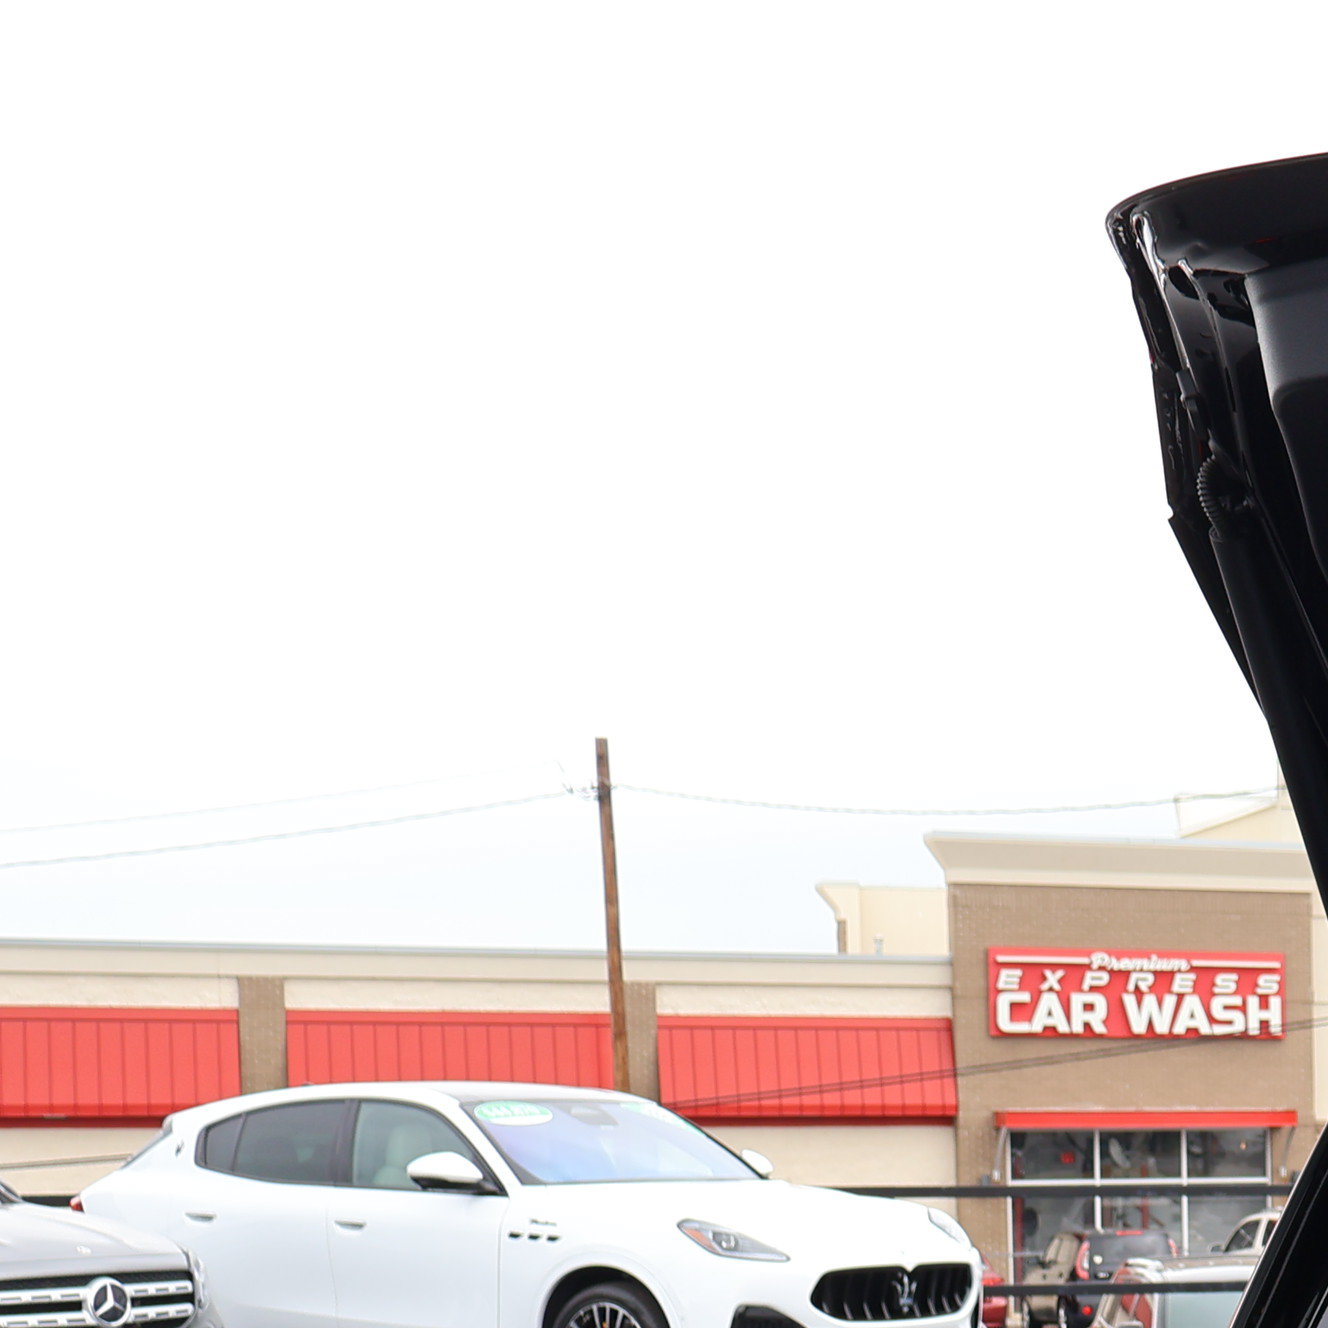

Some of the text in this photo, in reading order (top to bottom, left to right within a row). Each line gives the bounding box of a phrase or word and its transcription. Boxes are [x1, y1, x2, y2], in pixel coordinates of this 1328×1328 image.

[1090, 951, 1191, 972] Premium
[996, 968, 1282, 995] EXPRESS
[995, 991, 1283, 1036] CAR WASH
